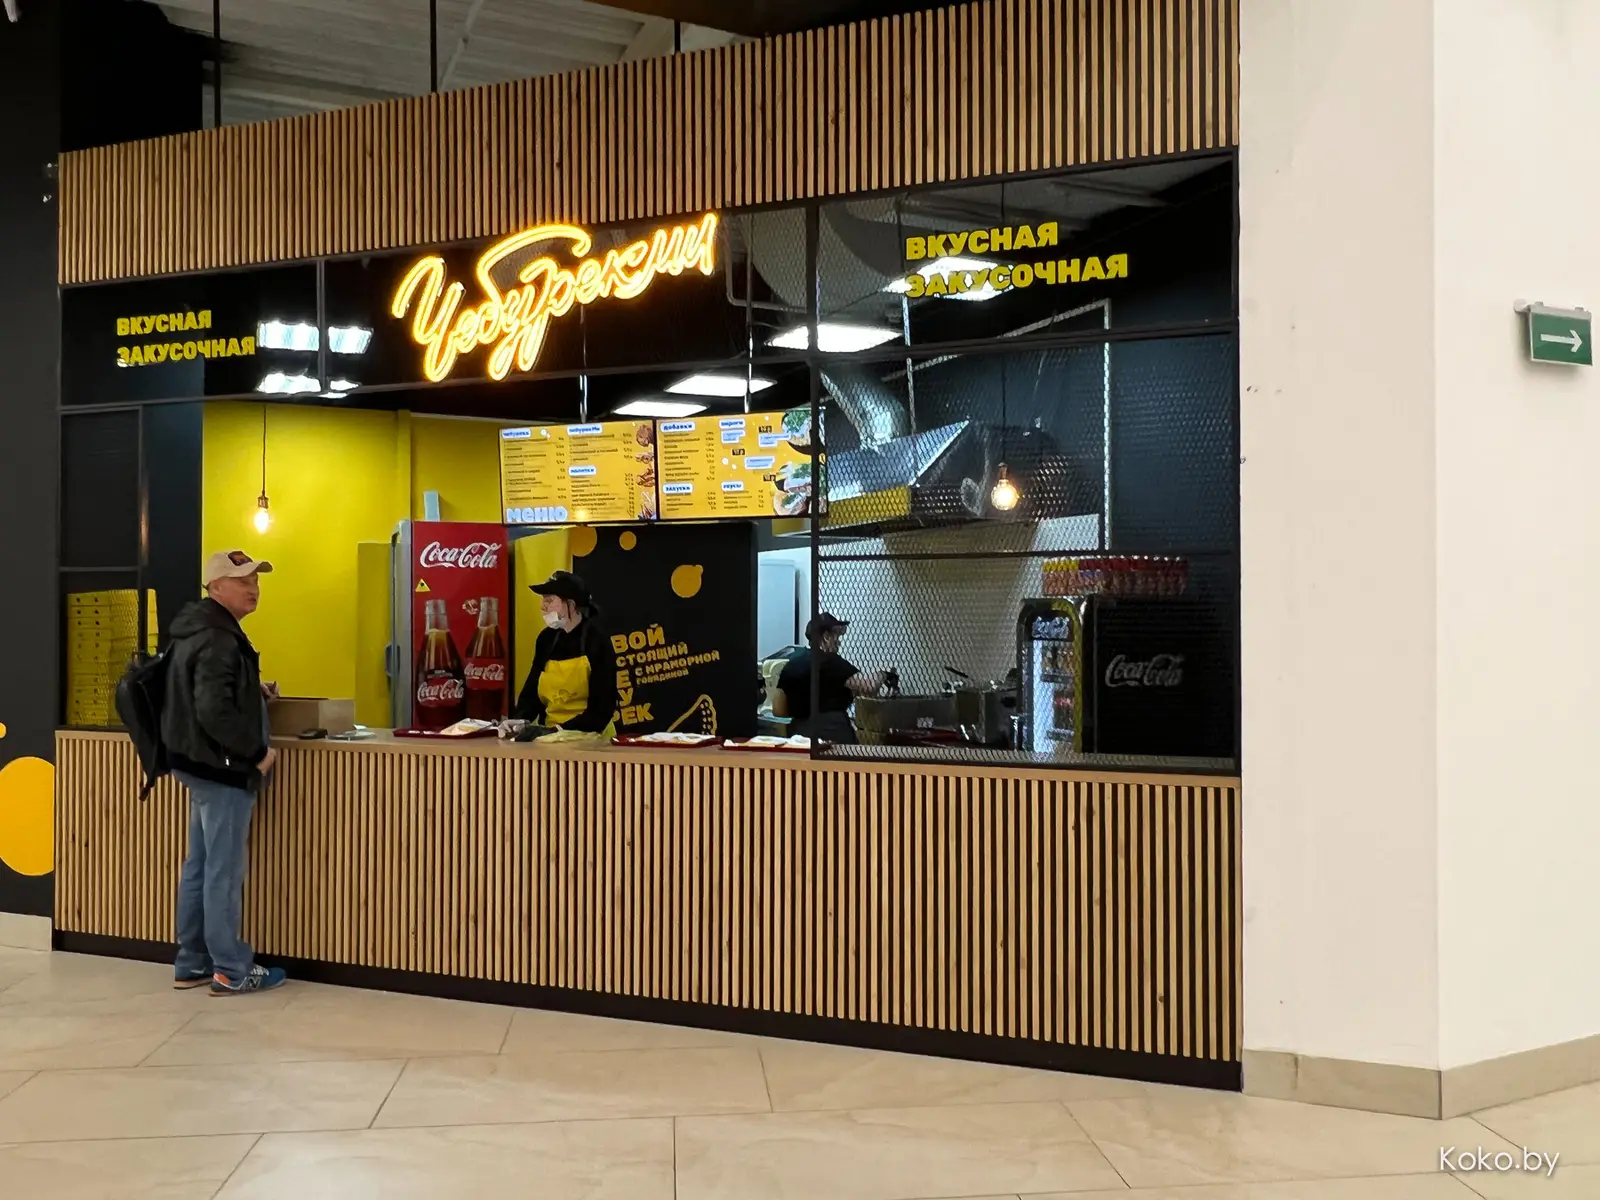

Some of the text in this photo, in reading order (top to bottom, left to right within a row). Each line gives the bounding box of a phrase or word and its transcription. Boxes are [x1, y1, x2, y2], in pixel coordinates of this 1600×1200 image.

[906, 222, 1058, 260] ВКУСНАЯ
[904, 254, 1128, 298] ЗАКУСОЧНАЯ
[116, 310, 212, 336] ВКУСНАЯ
[116, 336, 255, 367] ЗАКУСОЧНАЯ
[420, 541, 502, 568] Coca-Cola
[610, 623, 665, 654] ВОЙ
[616, 641, 688, 667] СТОЯЩИЙ
[645, 649, 720, 675] МРАМОРНОЙ
[1105, 654, 1184, 687] Coca-Cola
